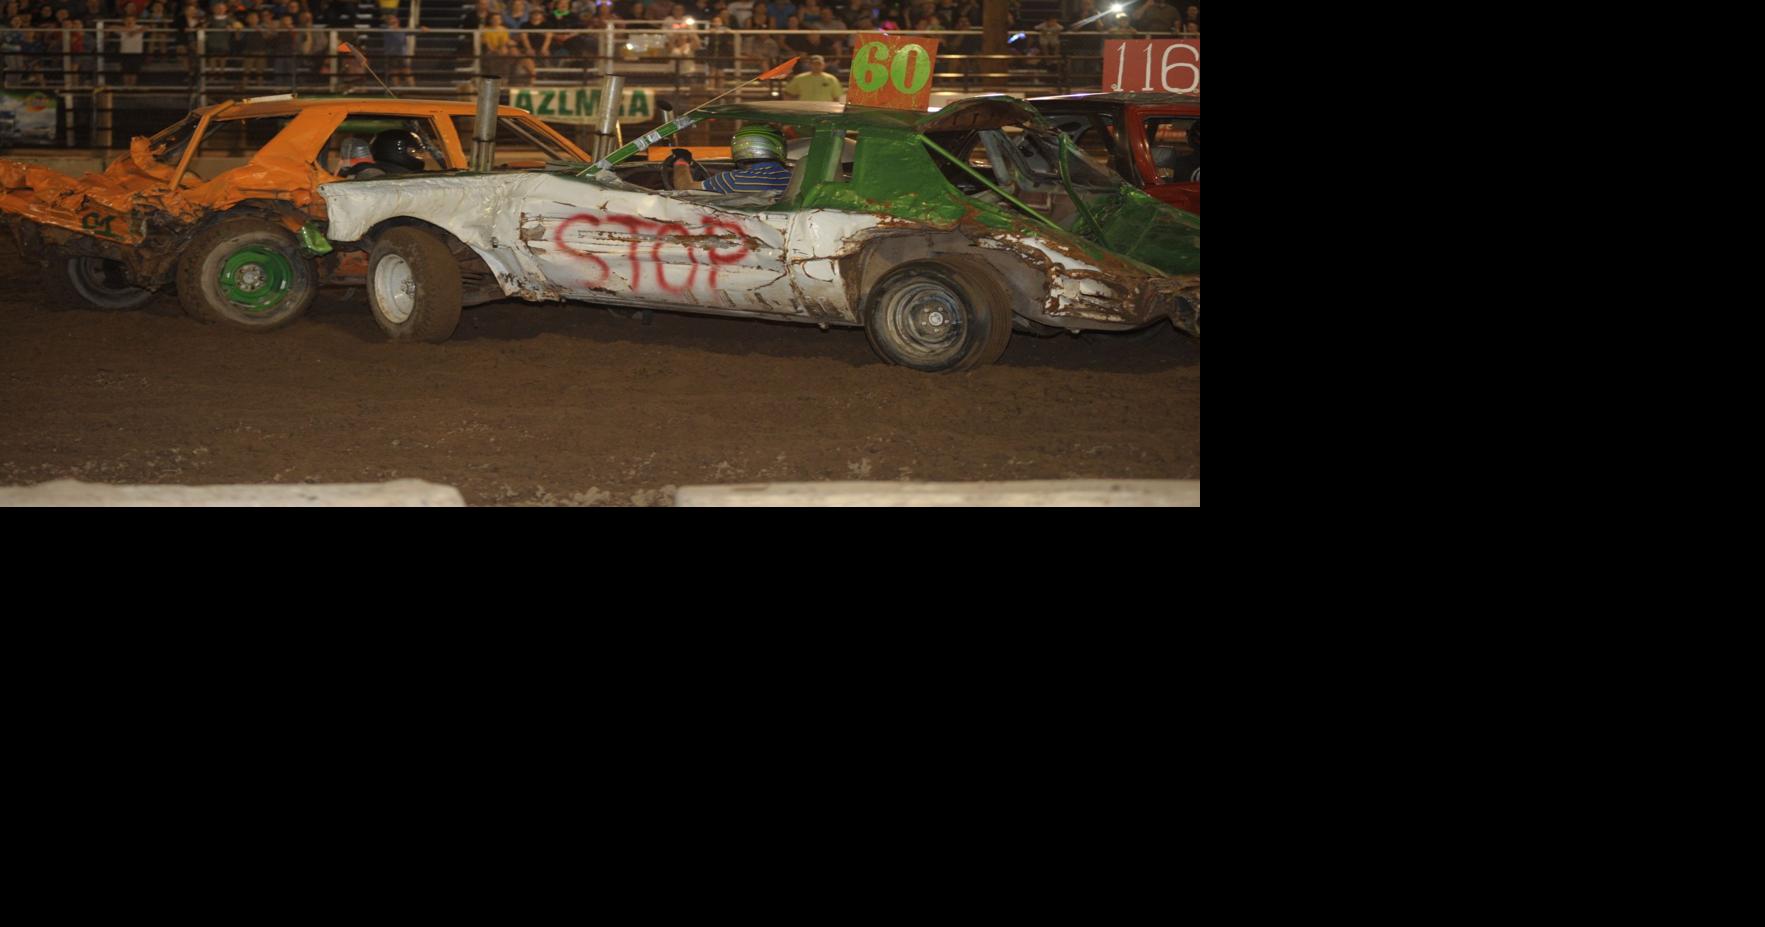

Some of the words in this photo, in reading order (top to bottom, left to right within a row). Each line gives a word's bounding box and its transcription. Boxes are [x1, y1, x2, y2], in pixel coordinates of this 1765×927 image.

[852, 41, 931, 94] 60
[1111, 42, 1200, 94] 116
[514, 89, 649, 116] AZLMA
[554, 213, 750, 297] STOP
